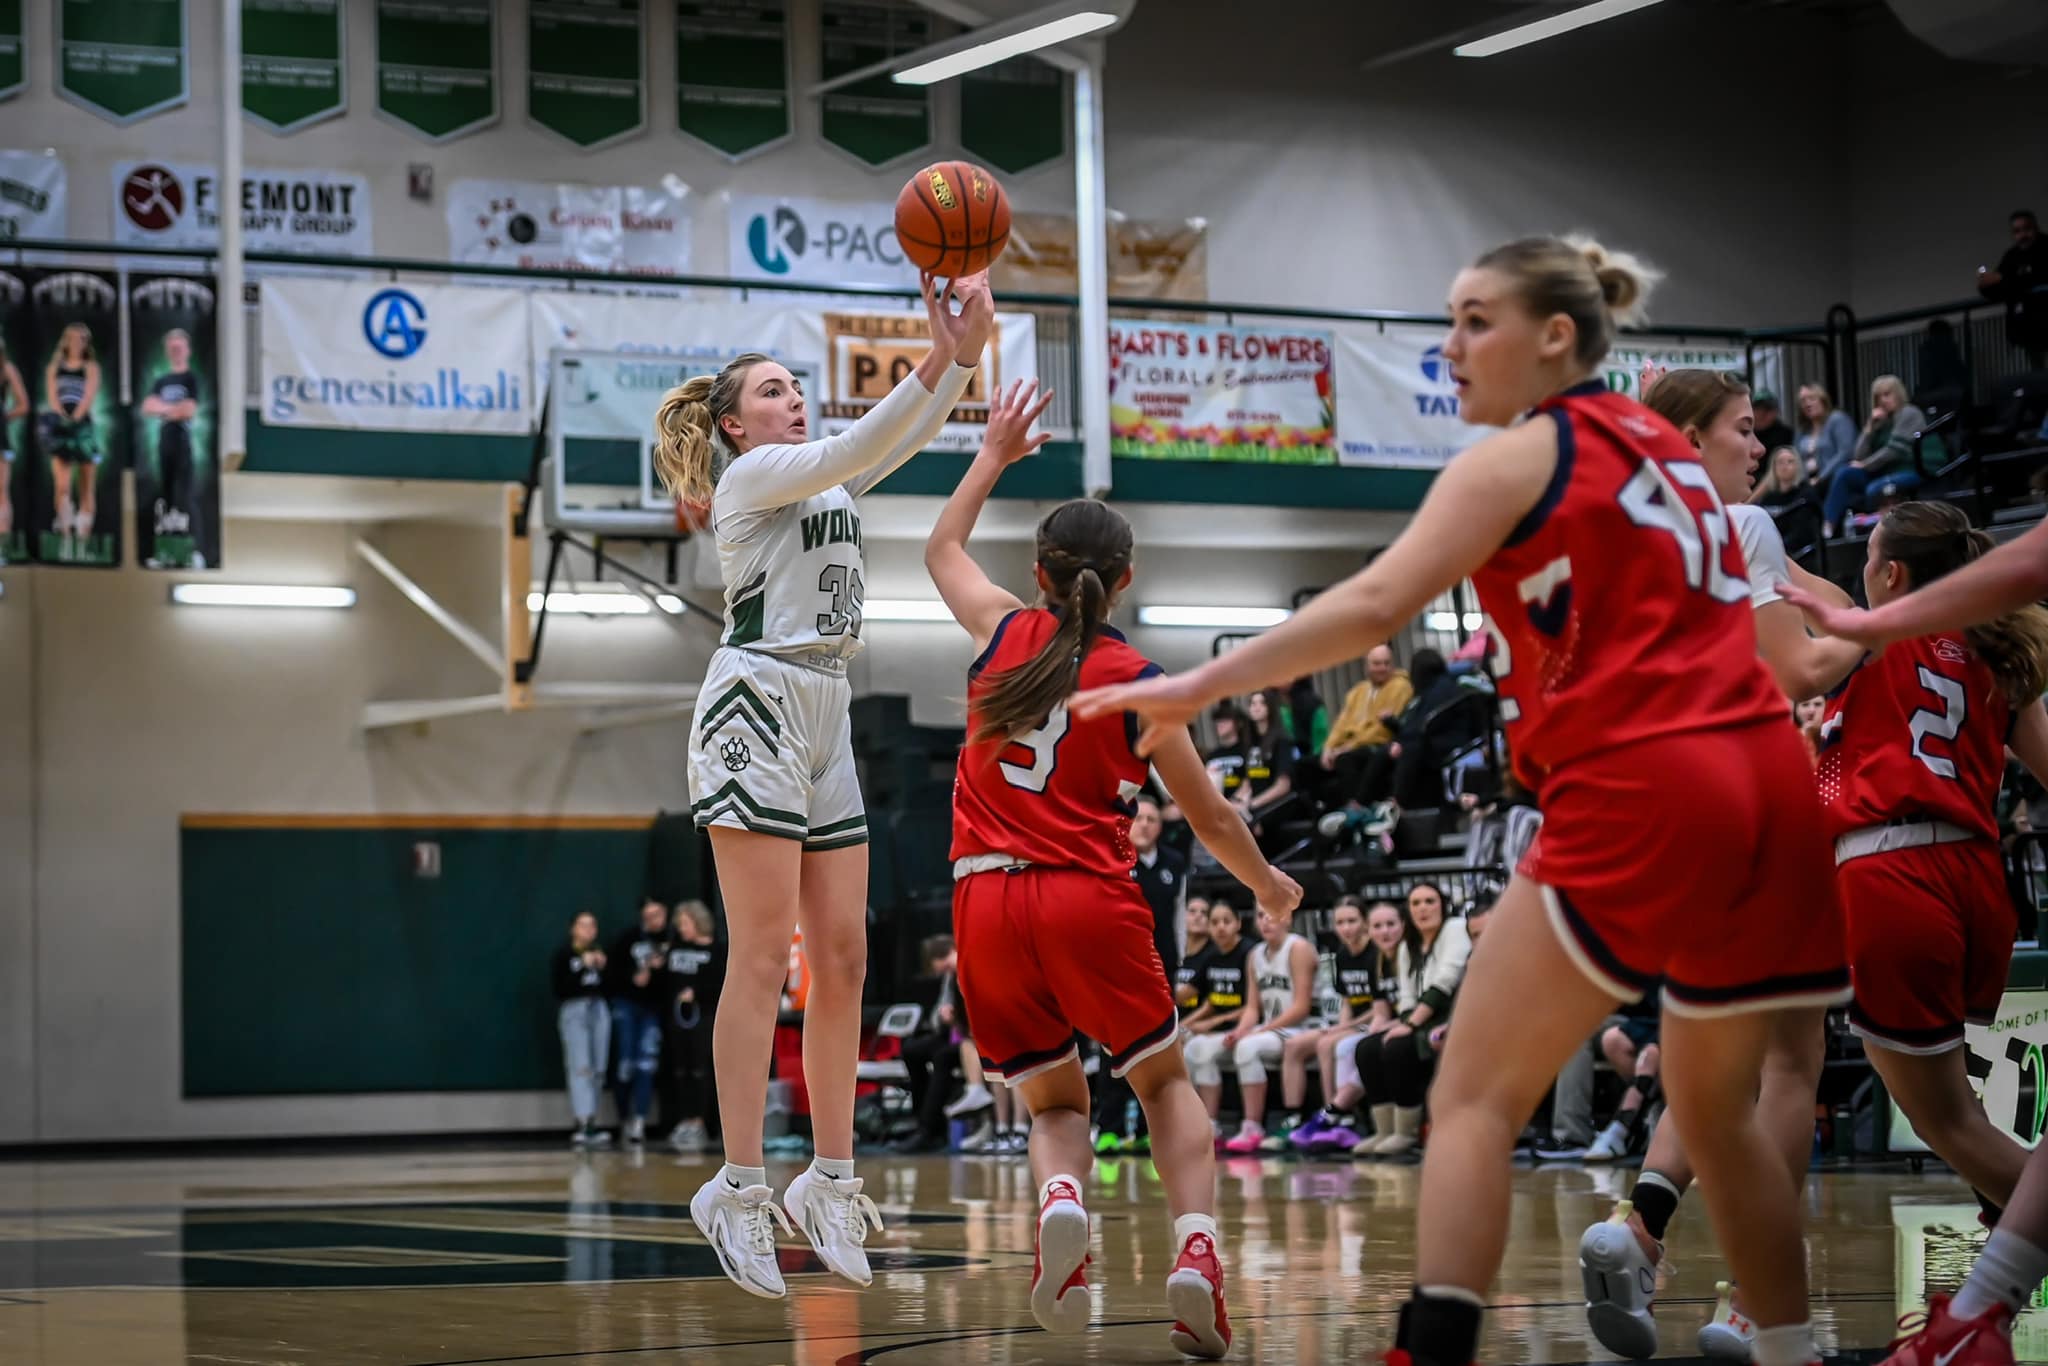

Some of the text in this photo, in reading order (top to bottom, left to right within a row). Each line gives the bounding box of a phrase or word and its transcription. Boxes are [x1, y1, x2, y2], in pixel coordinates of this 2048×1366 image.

[195, 177, 354, 215] FEMONT
[1215, 334, 1326, 364] FLOWERS
[271, 368, 521, 419] genesisalkali
[1120, 362, 1199, 387] FLORAL
[1415, 392, 1458, 417] TAT
[800, 507, 863, 560] WOLV
[1617, 457, 1751, 604] 42
[1908, 664, 1967, 779] 2
[2024, 1011, 2039, 1027] OF
